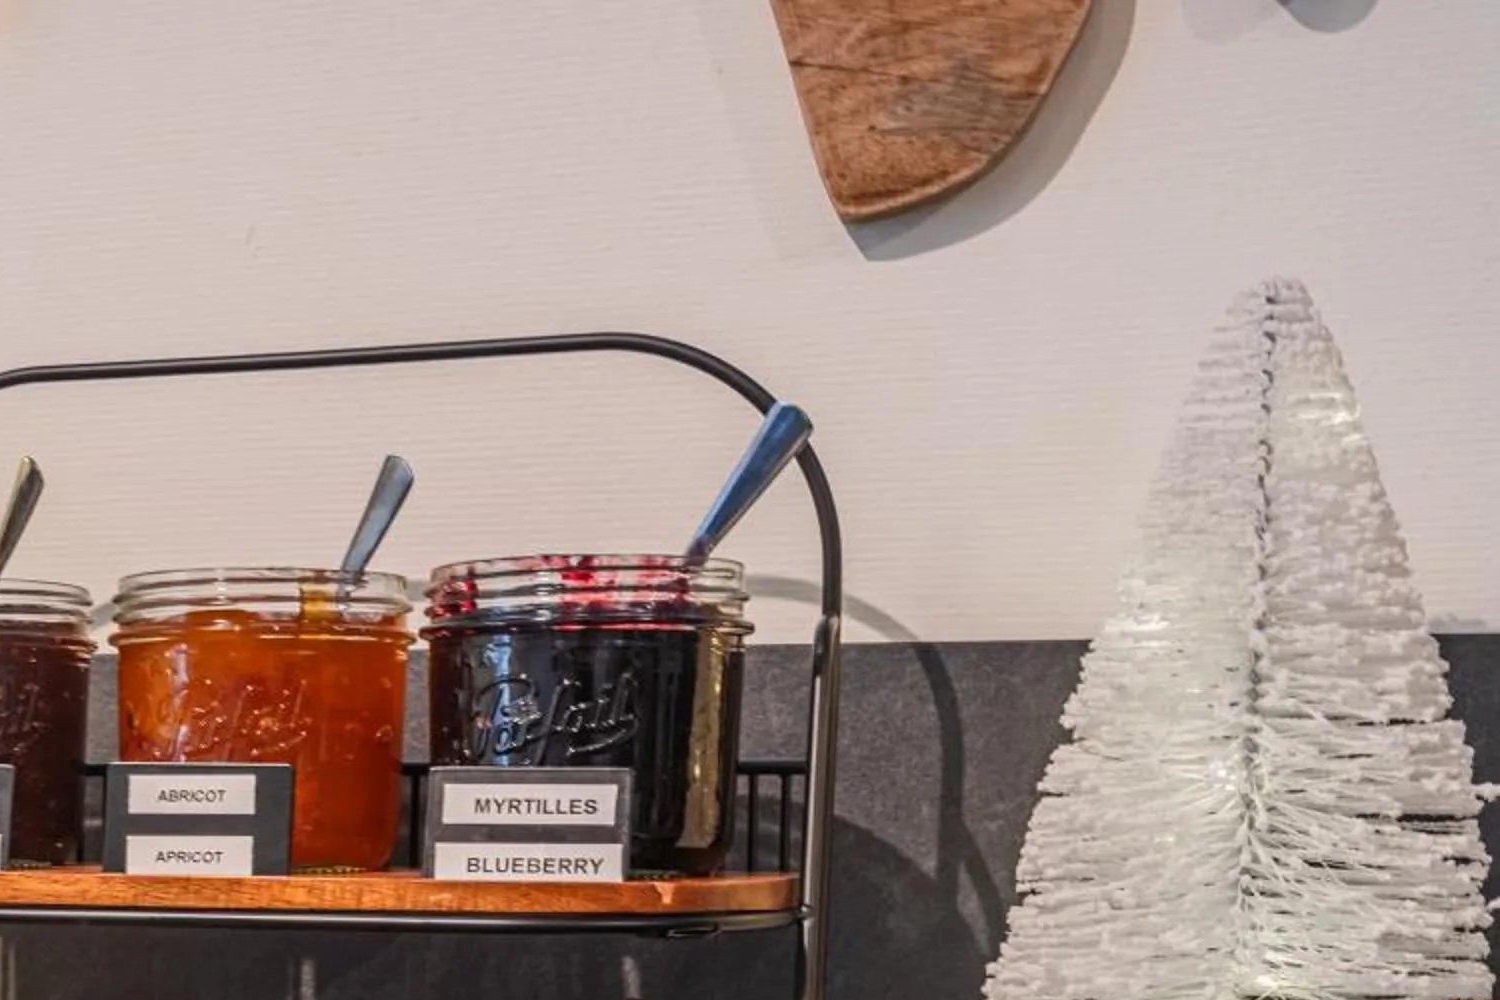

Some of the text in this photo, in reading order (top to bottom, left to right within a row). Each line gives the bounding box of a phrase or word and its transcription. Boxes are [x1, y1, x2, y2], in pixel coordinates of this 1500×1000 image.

[156, 789, 227, 803] ABRICOT
[473, 798, 599, 815] MYRTILLES
[154, 850, 225, 864] APRICOT
[466, 857, 605, 874] BLUEBERRY
